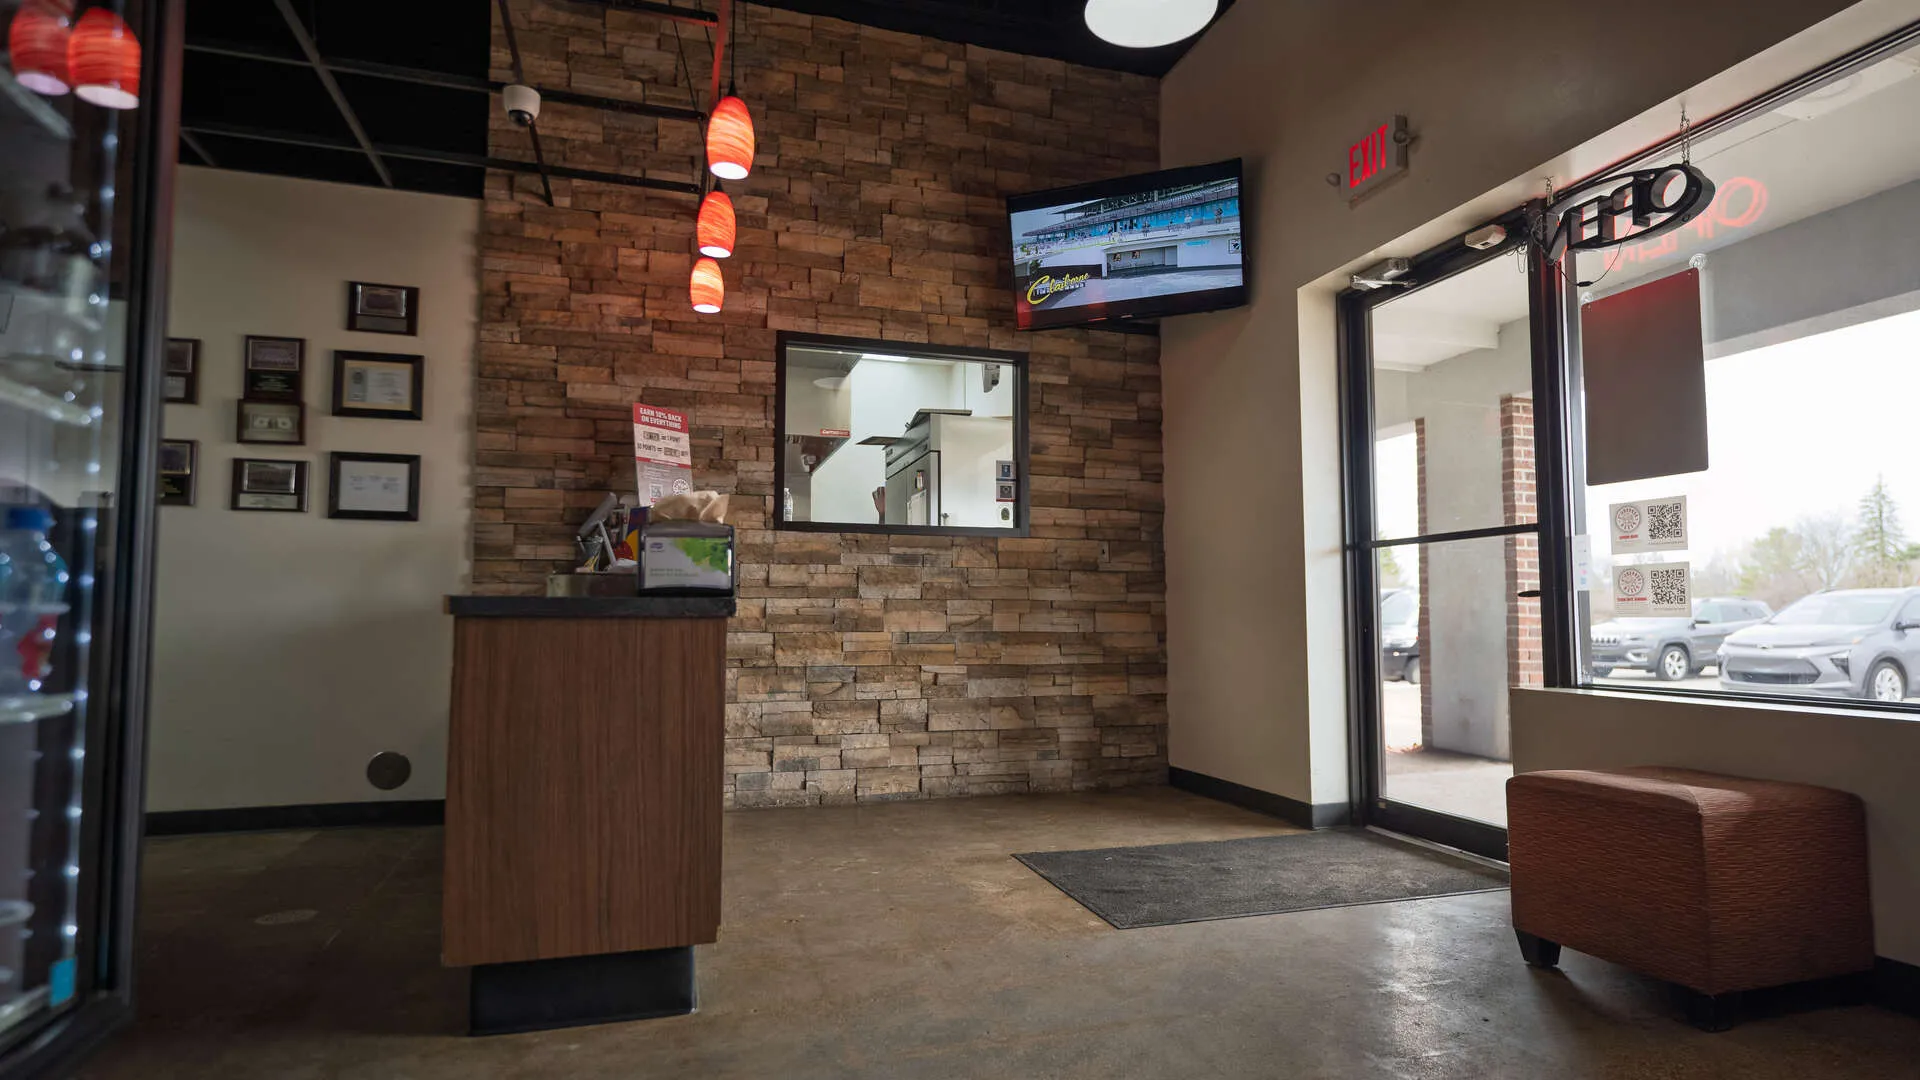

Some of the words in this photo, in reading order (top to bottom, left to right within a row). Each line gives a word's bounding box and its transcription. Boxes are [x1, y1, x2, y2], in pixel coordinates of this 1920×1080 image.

[1349, 123, 1388, 188] EXIT
[1027, 273, 1089, 305] Claiborne
[640, 407, 655, 416] EARN
[668, 413, 682, 422] BACK
[641, 415, 650, 423] ON
[650, 417, 682, 429] EVERYTHING
